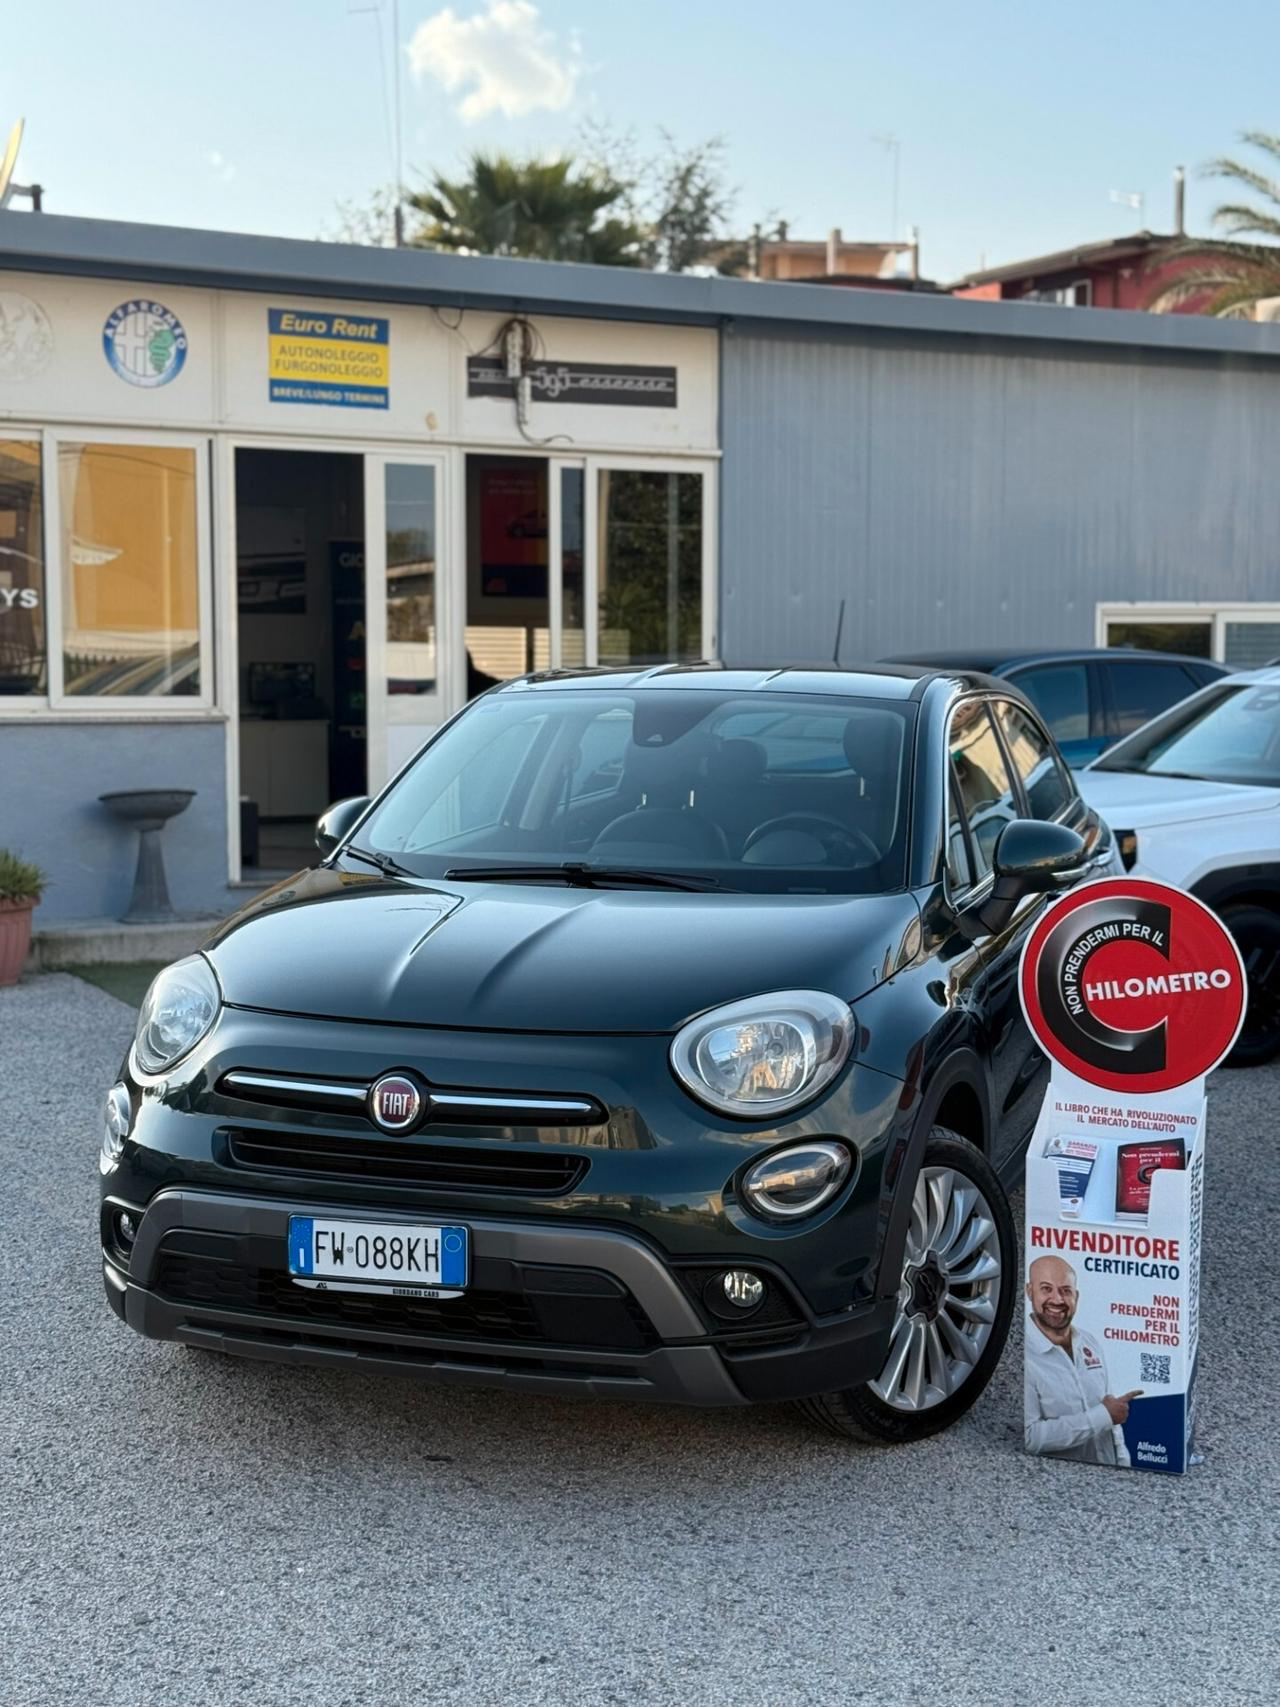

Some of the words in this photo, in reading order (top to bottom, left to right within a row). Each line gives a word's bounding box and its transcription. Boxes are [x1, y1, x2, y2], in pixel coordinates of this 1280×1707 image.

[281, 313, 327, 333] Euro
[332, 318, 378, 339] Rent
[279, 344, 380, 364] AUTONOLEGGIO
[274, 358, 384, 378] FURGONOLEGGIO
[1122, 923, 1151, 939] PER
[1152, 930, 1164, 946] IL
[1064, 923, 1120, 983] PRENDERMI
[1064, 986, 1084, 1015] NON
[382, 1092, 410, 1116] FIAT
[1055, 1102, 1063, 1111] IL
[1064, 1103, 1090, 1114] LIBRO
[1092, 1106, 1109, 1116] CHE
[1110, 1108, 1123, 1118] HA
[1126, 1109, 1198, 1125] RIVOLUZIONATO
[1077, 1114, 1085, 1123] IL
[1088, 1115, 1130, 1129] MERCATO
[1131, 1119, 1176, 1133] DELL'AUTO
[1031, 1226, 1180, 1261] RIVENDITORE
[1084, 1257, 1180, 1281] CERTIFICATO
[423, 1290, 440, 1299] CARS
[1153, 1294, 1180, 1308] NON
[1110, 1303, 1180, 1321] PRENDERMI
[1103, 1327, 1180, 1347] CHILOMETRO
[1144, 1319, 1167, 1332] PER
[1169, 1322, 1180, 1335] IL
[1137, 1441, 1167, 1454] Alfredo
[1137, 1451, 1169, 1464] Bellucci
